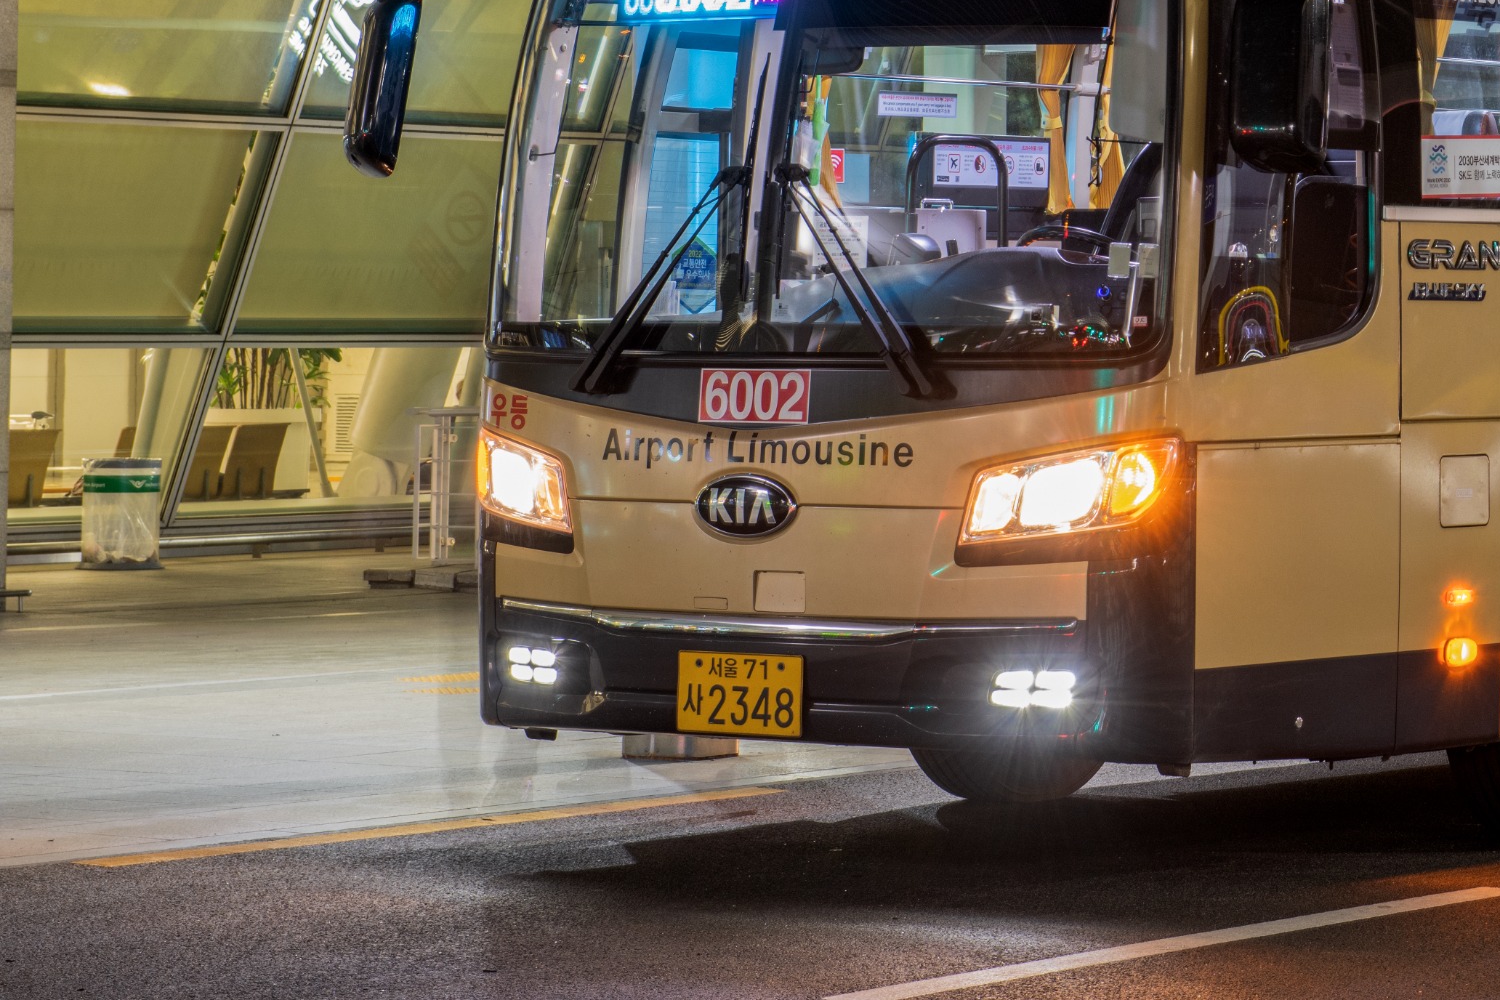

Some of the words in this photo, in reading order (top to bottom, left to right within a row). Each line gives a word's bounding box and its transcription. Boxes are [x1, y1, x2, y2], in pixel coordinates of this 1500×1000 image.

[491, 393, 528, 430] 우등
[705, 371, 805, 421] 6002
[602, 427, 714, 469] Airport
[727, 430, 914, 468] Limousine
[709, 487, 777, 524] KIA
[708, 657, 738, 679] 서울
[743, 658, 768, 680] 71
